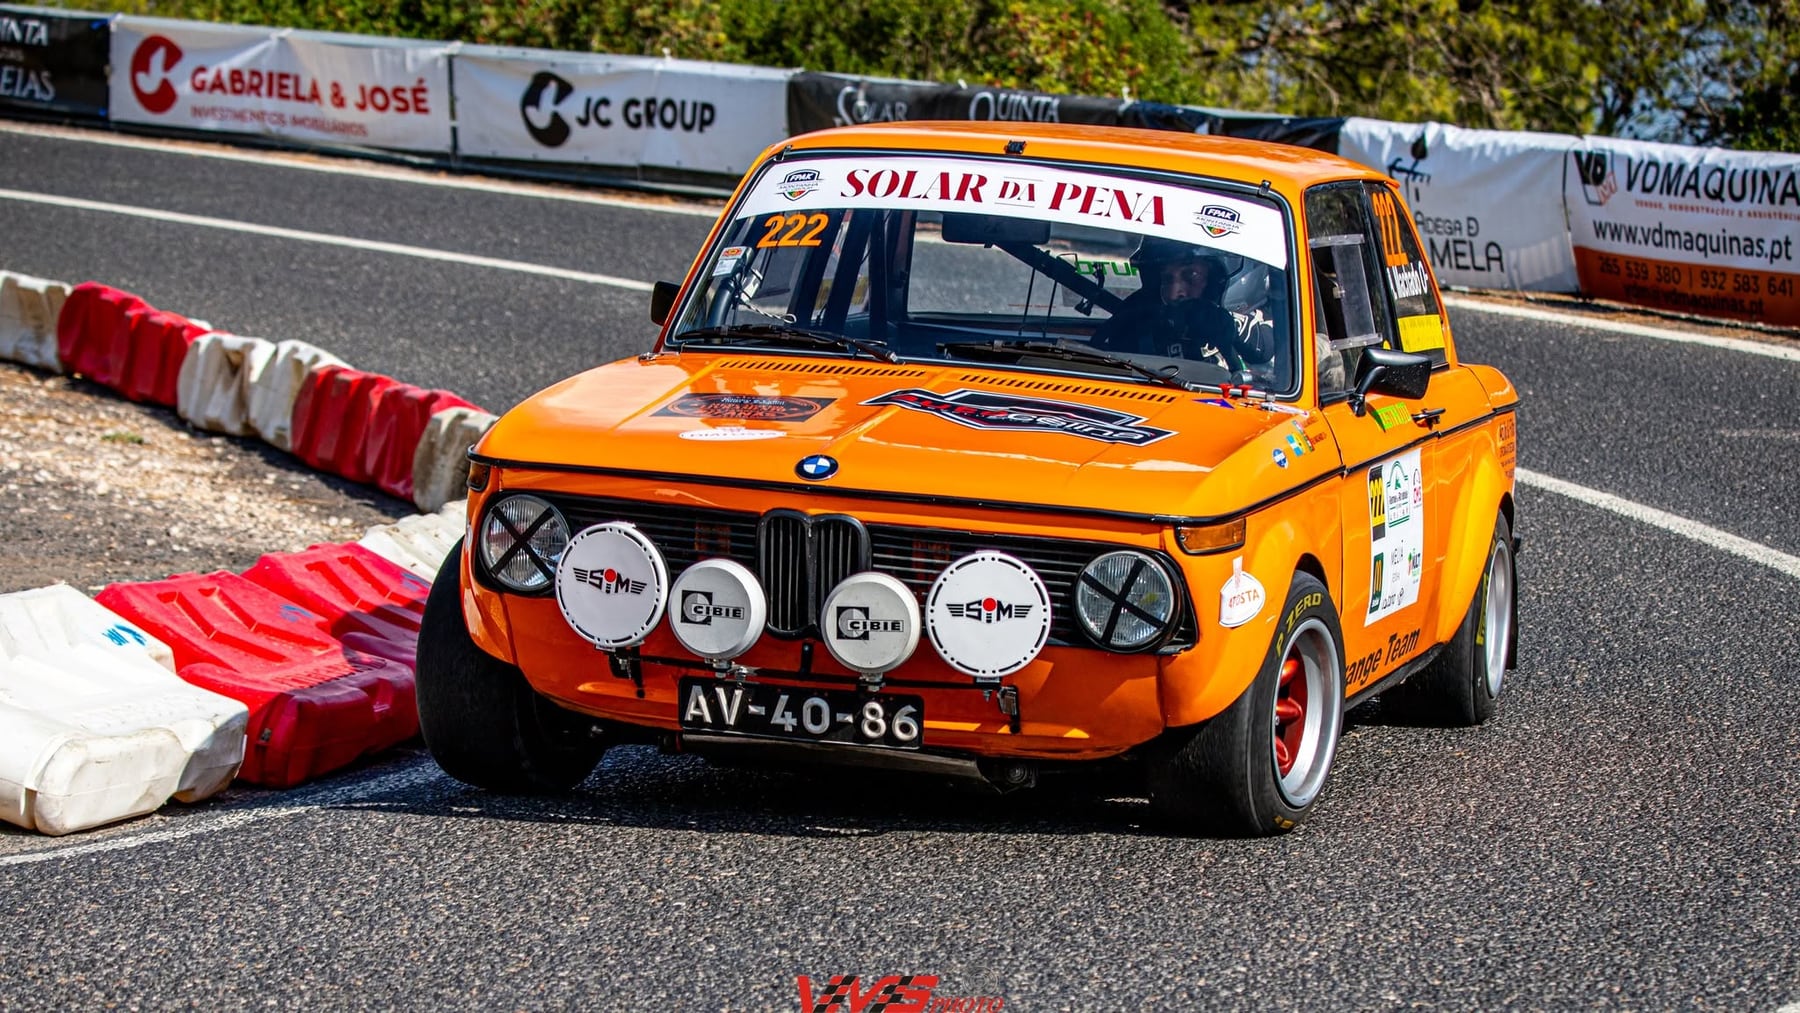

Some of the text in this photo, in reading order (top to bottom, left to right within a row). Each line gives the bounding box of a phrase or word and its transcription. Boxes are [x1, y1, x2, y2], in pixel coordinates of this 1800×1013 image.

[191, 66, 430, 114] GABRIELA & JOSÉ
[968, 91, 1060, 124] QUINTA
[577, 98, 716, 134] JC GROUP
[840, 168, 1166, 226] SOLAR DA PENA
[1206, 207, 1235, 221] FPAK
[757, 213, 829, 249] 222
[1373, 192, 1409, 267] 222
[1593, 220, 1793, 265] www.vdmaquinas.pt
[1625, 262, 1649, 280] 539
[1655, 265, 1681, 285] 380
[1701, 270, 1727, 290] 932
[1732, 273, 1760, 294] 583
[1766, 275, 1793, 297] 641
[692, 604, 743, 619] CIBIE
[848, 620, 903, 632] CIBIE
[1285, 592, 1323, 634] ZERO
[1385, 628, 1420, 665] Team
[684, 684, 919, 742] AV-40-86
